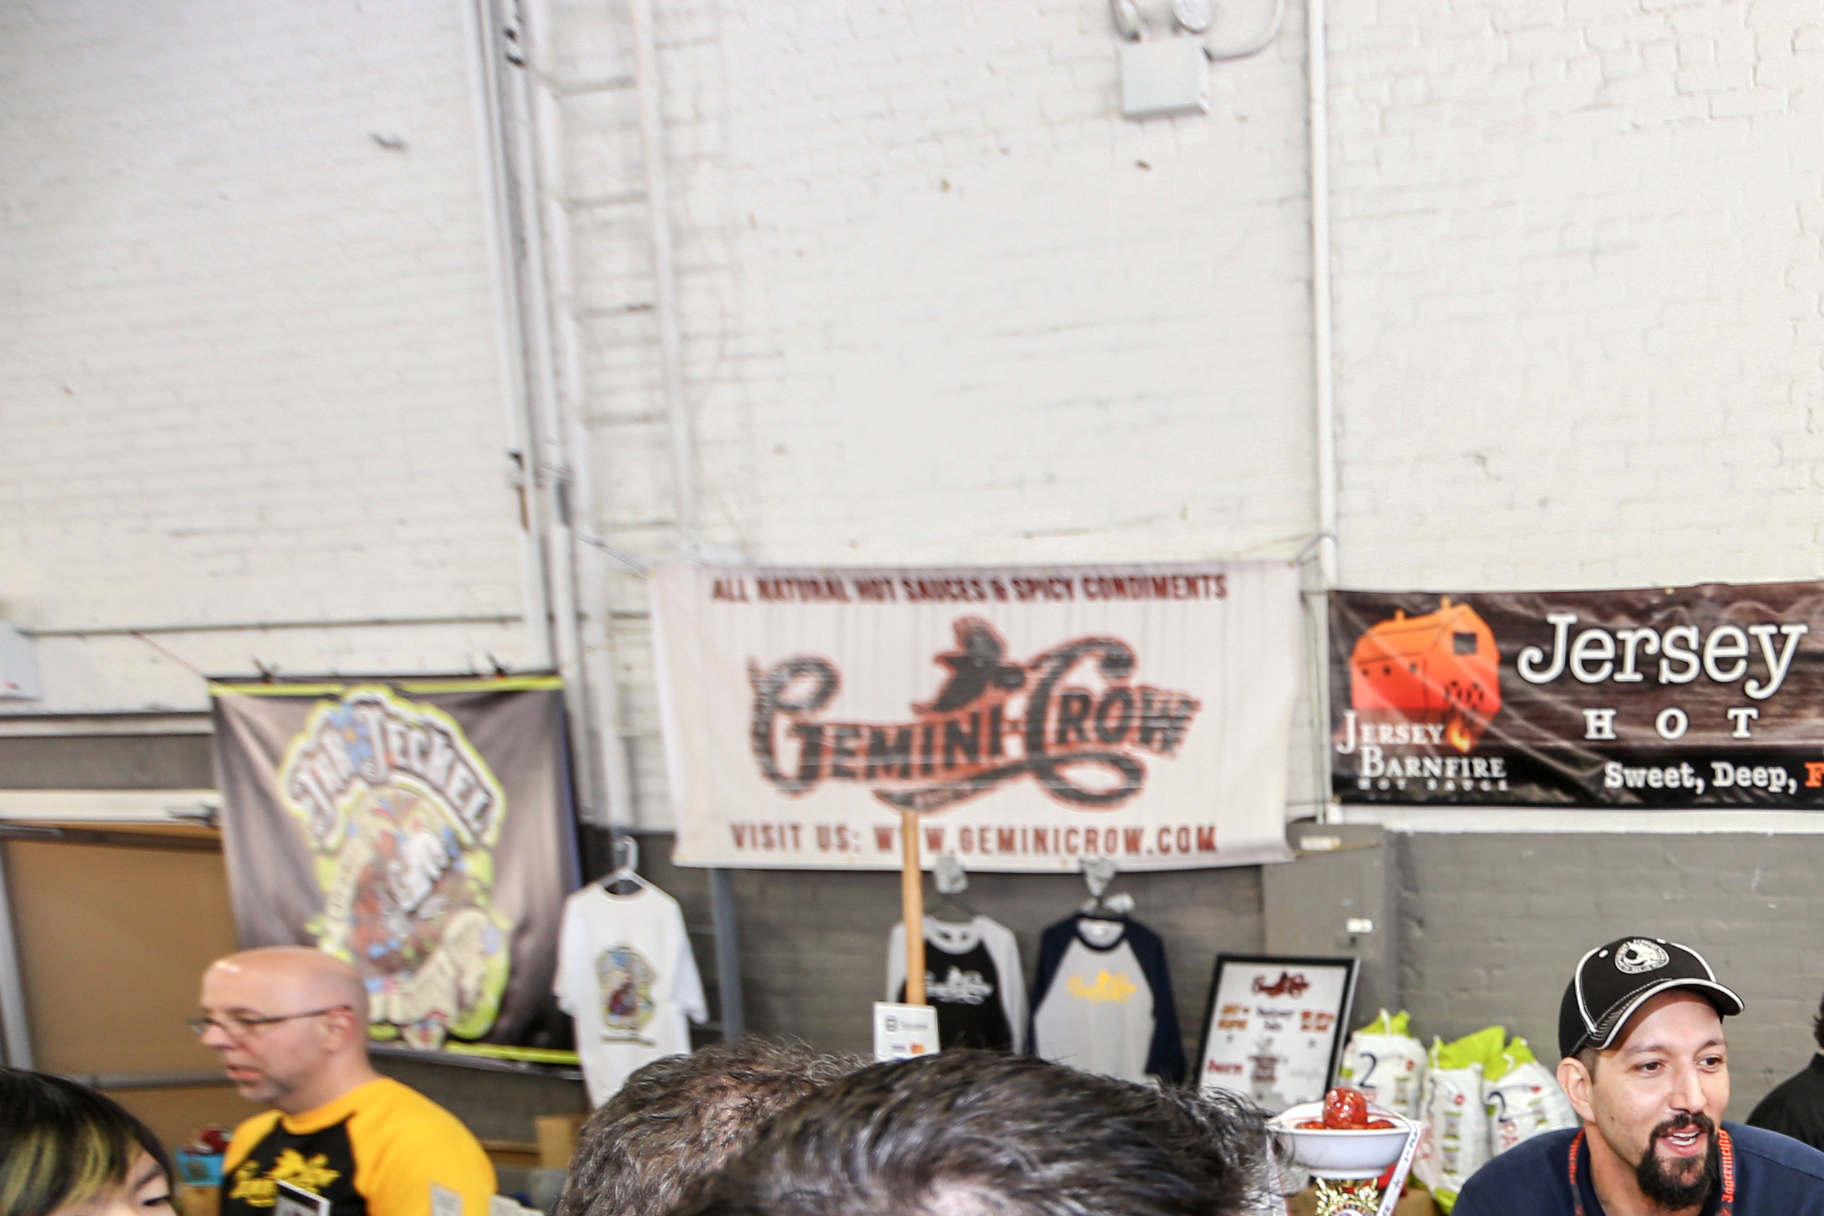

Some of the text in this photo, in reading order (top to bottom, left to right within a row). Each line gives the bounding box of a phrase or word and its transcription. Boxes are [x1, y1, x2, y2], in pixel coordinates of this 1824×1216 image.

[712, 578, 749, 602] ALL
[756, 578, 851, 602] NATURAL
[853, 578, 896, 602] HOT
[901, 577, 987, 601] SAUCES
[1011, 577, 1074, 600] SPICY
[1082, 574, 1228, 599] CONDIMENTS
[1517, 612, 1809, 700] Jersey
[1336, 709, 1445, 754] JERSEY
[1583, 707, 1759, 741] HOT
[1359, 746, 1507, 778] BARNFIRE
[1604, 761, 1705, 795] Sweet,
[1711, 761, 1798, 795] Deep,
[730, 823, 1218, 854] VISIT US: WW.GEMINICROW.COM
